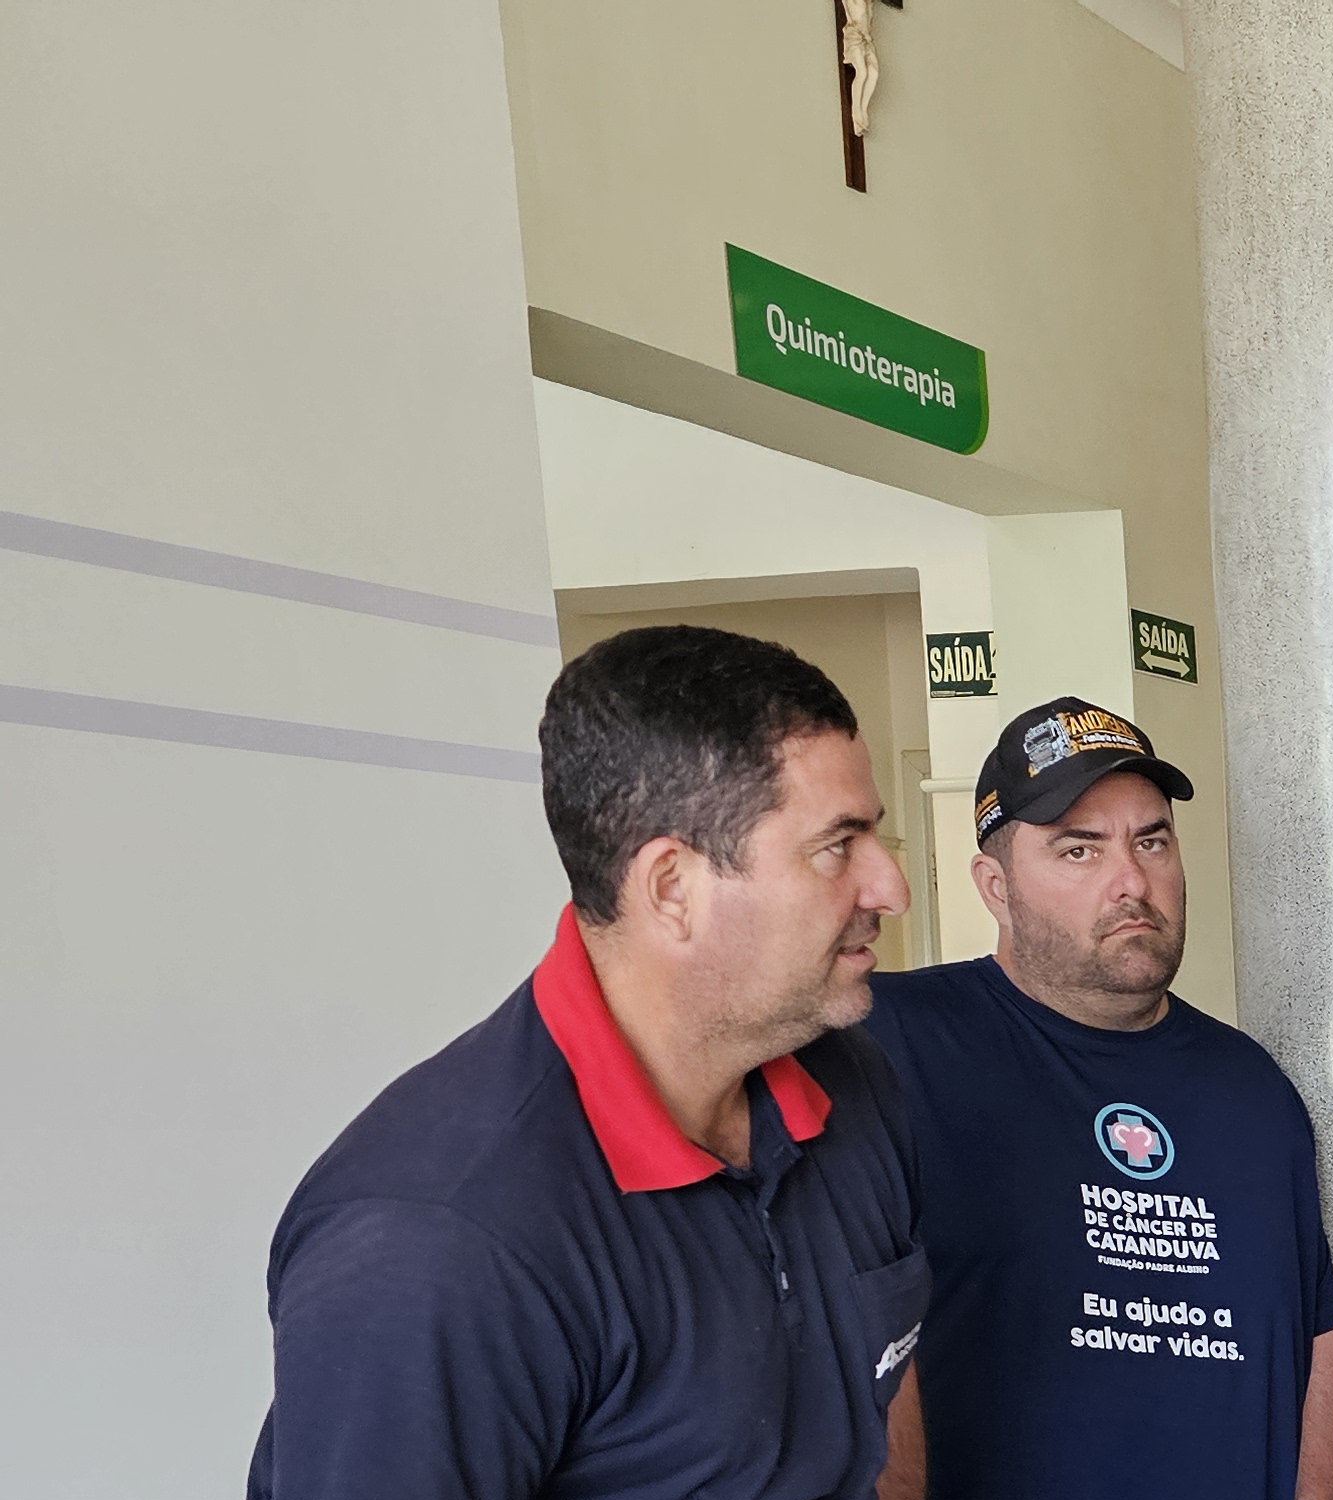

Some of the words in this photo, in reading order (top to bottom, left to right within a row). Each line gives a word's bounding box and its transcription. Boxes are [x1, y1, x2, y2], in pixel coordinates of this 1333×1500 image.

[765, 302, 956, 409] Quimioterapia
[1138, 621, 1190, 659] SAÍDA
[929, 636, 989, 684] SAÍDA
[1080, 1183, 1216, 1220] HOSPITAL
[1083, 1208, 1110, 1228] DE
[1112, 1212, 1188, 1238] CÂNCER
[1191, 1222, 1218, 1239] DE
[1085, 1228, 1221, 1261] CATANDUVA
[1097, 1254, 1144, 1271] FUNDAÇÃO
[1145, 1261, 1175, 1273] PADRE
[1176, 1264, 1210, 1275] ALBINO
[1083, 1292, 1118, 1319] Eu
[1124, 1296, 1208, 1328] ajudo
[1212, 1307, 1233, 1328] a
[1069, 1325, 1162, 1354] salvar
[1166, 1331, 1246, 1362] vidas.
